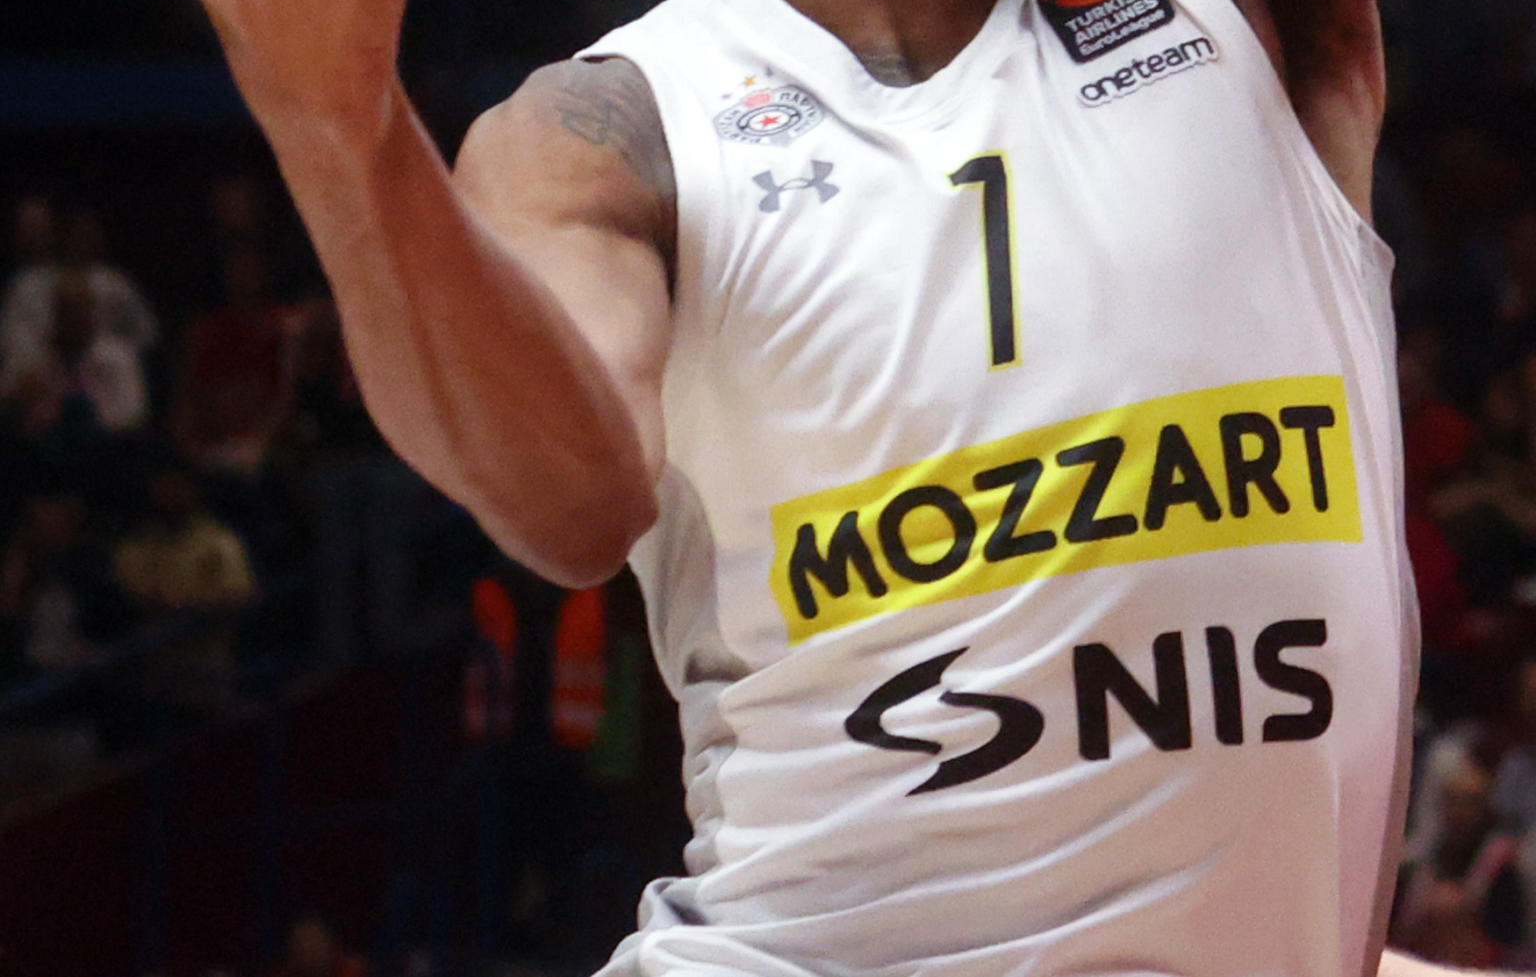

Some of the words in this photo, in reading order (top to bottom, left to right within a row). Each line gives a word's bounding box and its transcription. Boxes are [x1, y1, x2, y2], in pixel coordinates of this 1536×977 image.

[1080, 36, 1214, 101] oneteam
[946, 151, 1018, 369] 1
[787, 404, 1336, 621] MOZZART
[1072, 618, 1334, 761] NIS
